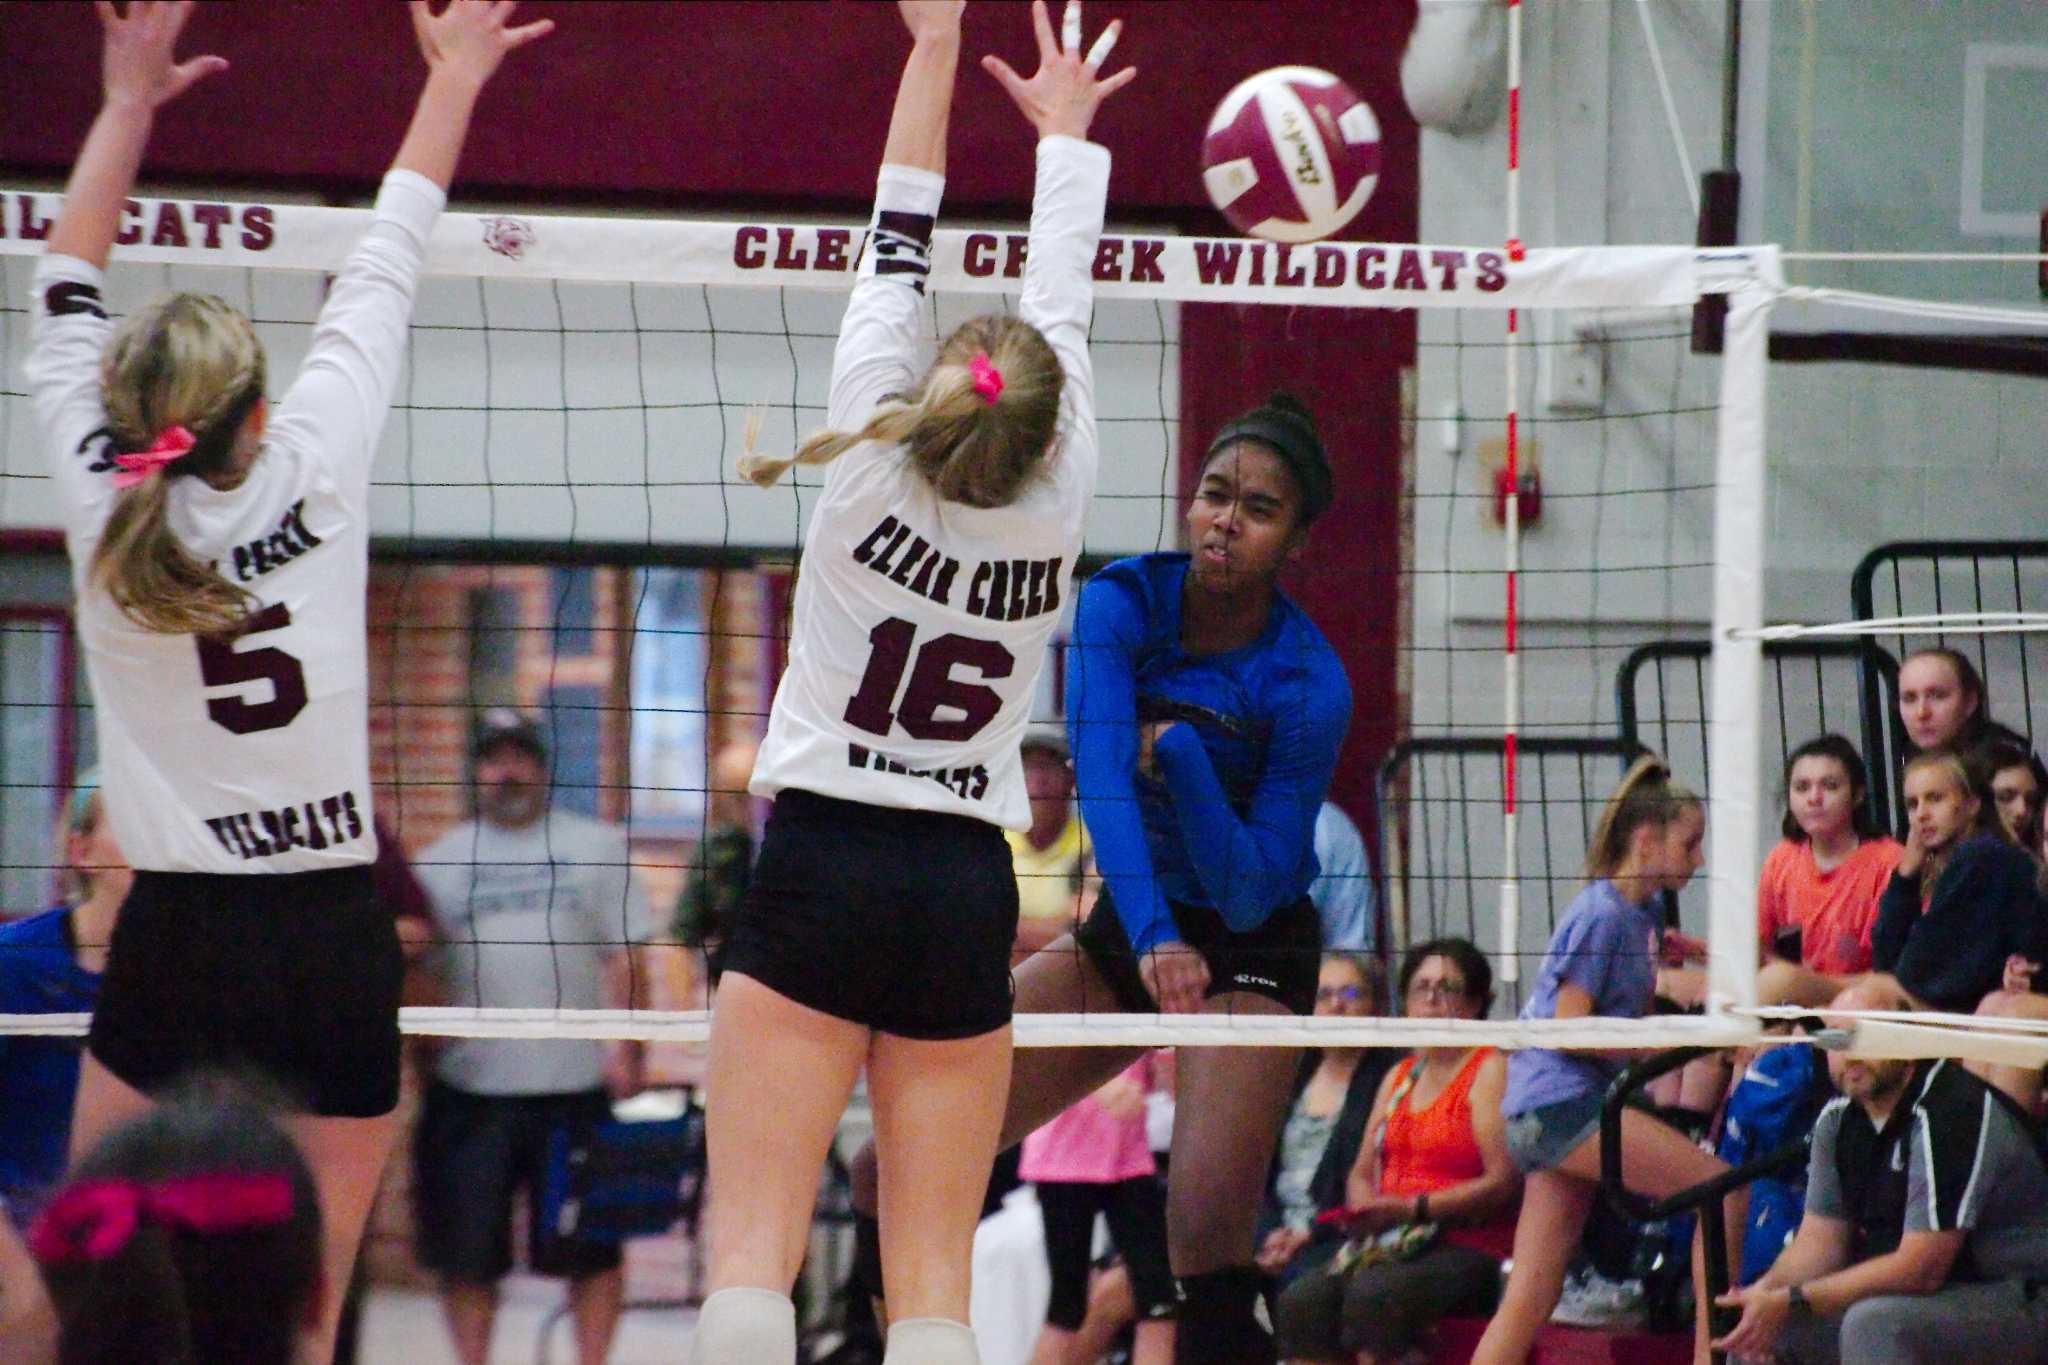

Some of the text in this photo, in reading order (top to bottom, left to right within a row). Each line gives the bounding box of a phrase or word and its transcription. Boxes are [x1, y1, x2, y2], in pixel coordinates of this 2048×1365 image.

[1194, 241, 1507, 293] WILDCATS
[852, 514, 1063, 622] CLEAR CREEK
[194, 601, 309, 736] 5
[842, 616, 1015, 741] 16
